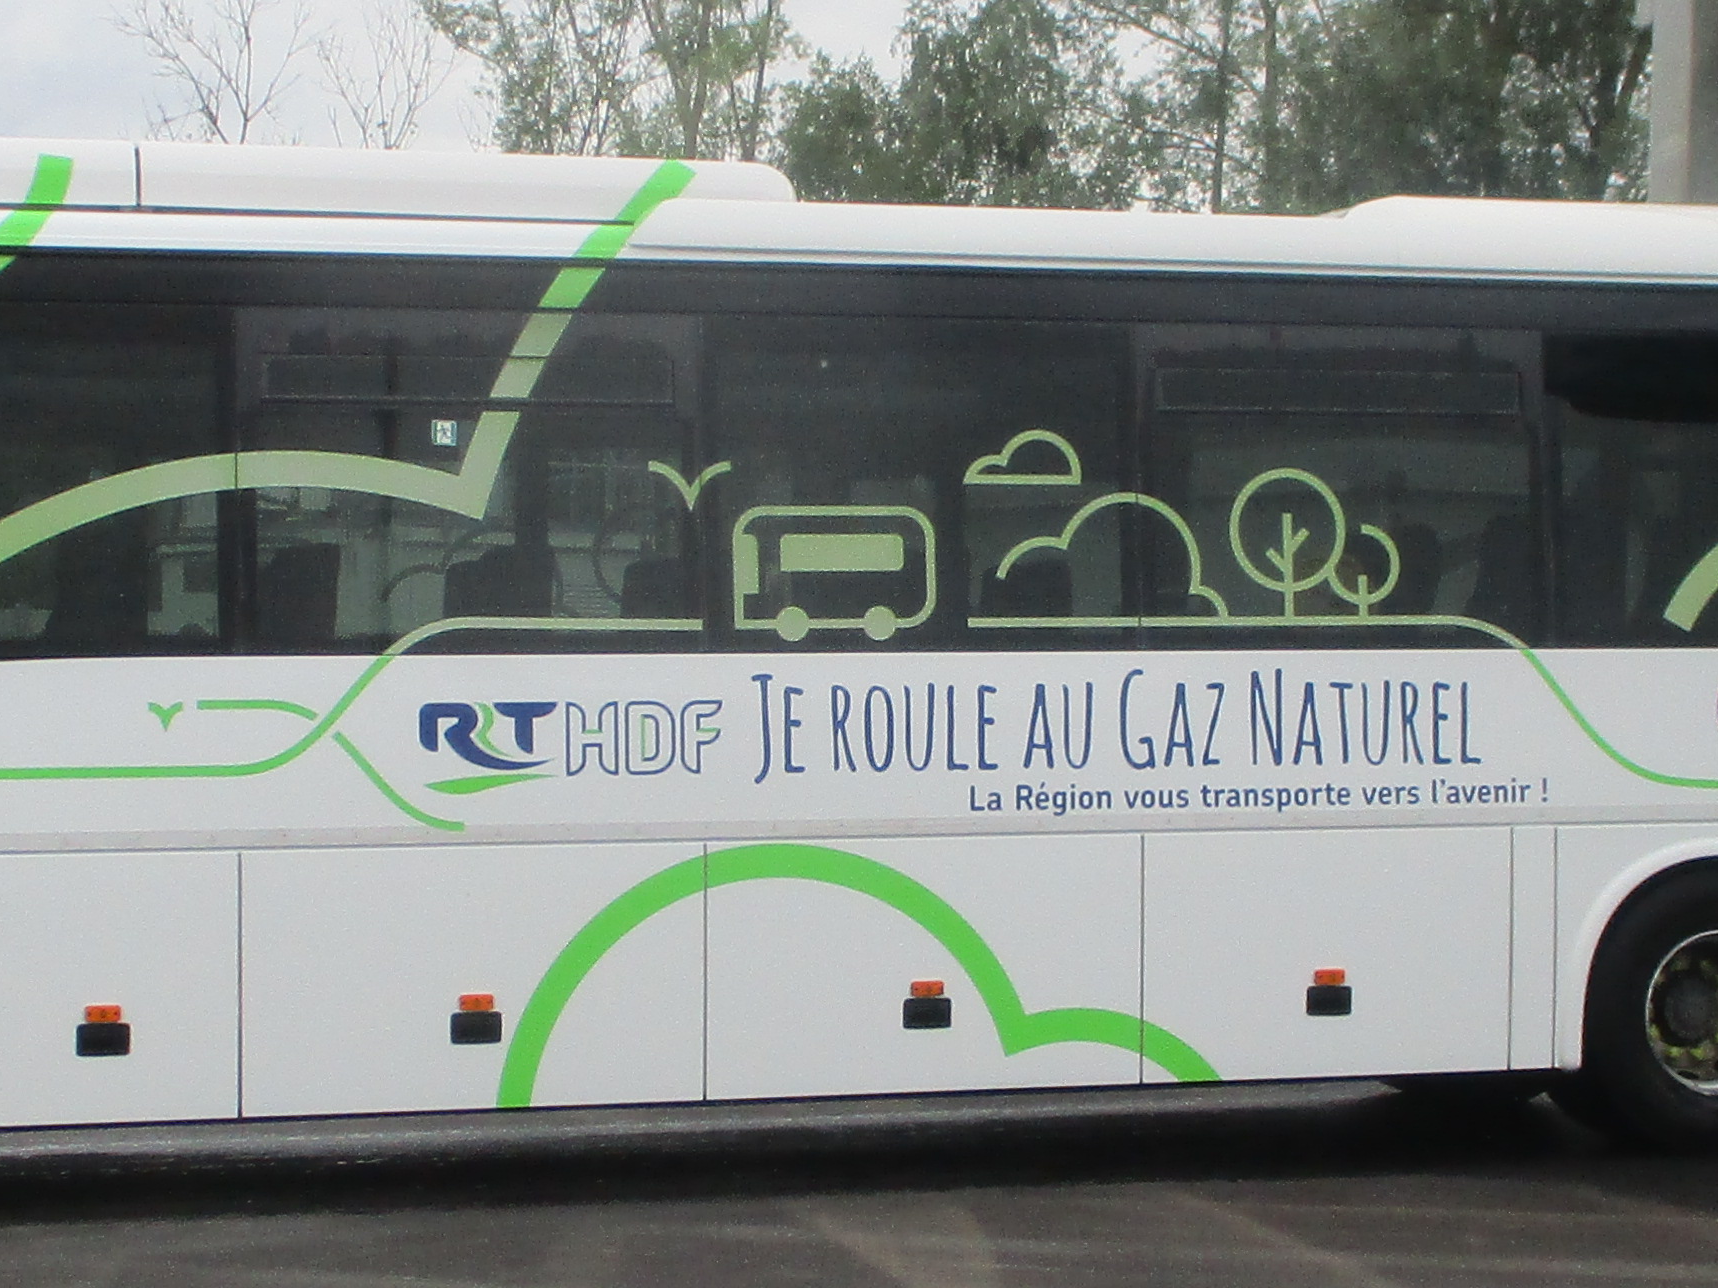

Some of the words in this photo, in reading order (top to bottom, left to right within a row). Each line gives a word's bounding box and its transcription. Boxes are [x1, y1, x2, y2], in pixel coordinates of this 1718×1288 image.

[832, 684, 1001, 774] ROULE
[1023, 683, 1096, 771] AU
[1119, 668, 1227, 771] GAZ
[1250, 667, 1484, 768] NATUREL
[969, 785, 1003, 812] La
[1015, 781, 1112, 817] Région
[1124, 789, 1190, 810] vous
[1200, 783, 1351, 813] transporte
[1362, 785, 1421, 806] vers
[1432, 778, 1532, 805] l'avenir
